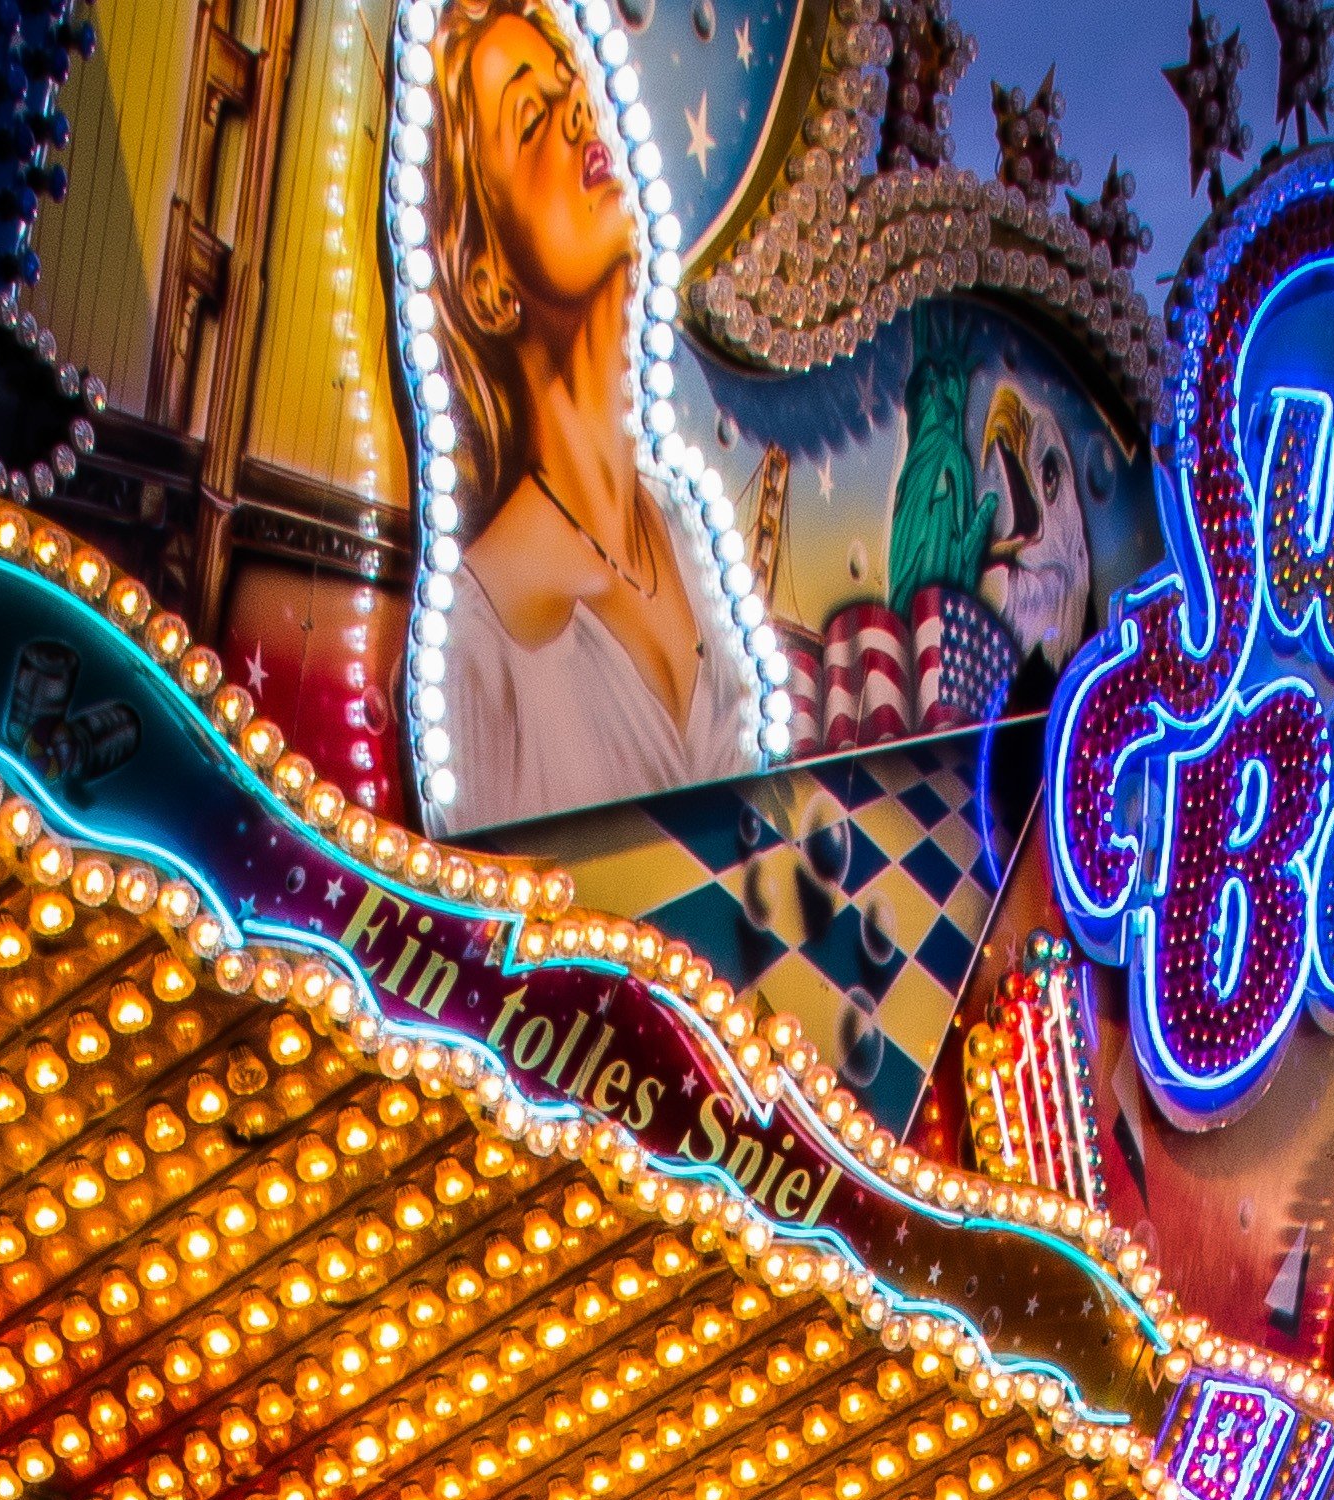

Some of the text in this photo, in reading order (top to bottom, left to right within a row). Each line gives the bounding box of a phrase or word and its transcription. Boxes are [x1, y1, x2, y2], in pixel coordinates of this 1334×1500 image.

[340, 880, 842, 1230] Ein tolles Spiel
